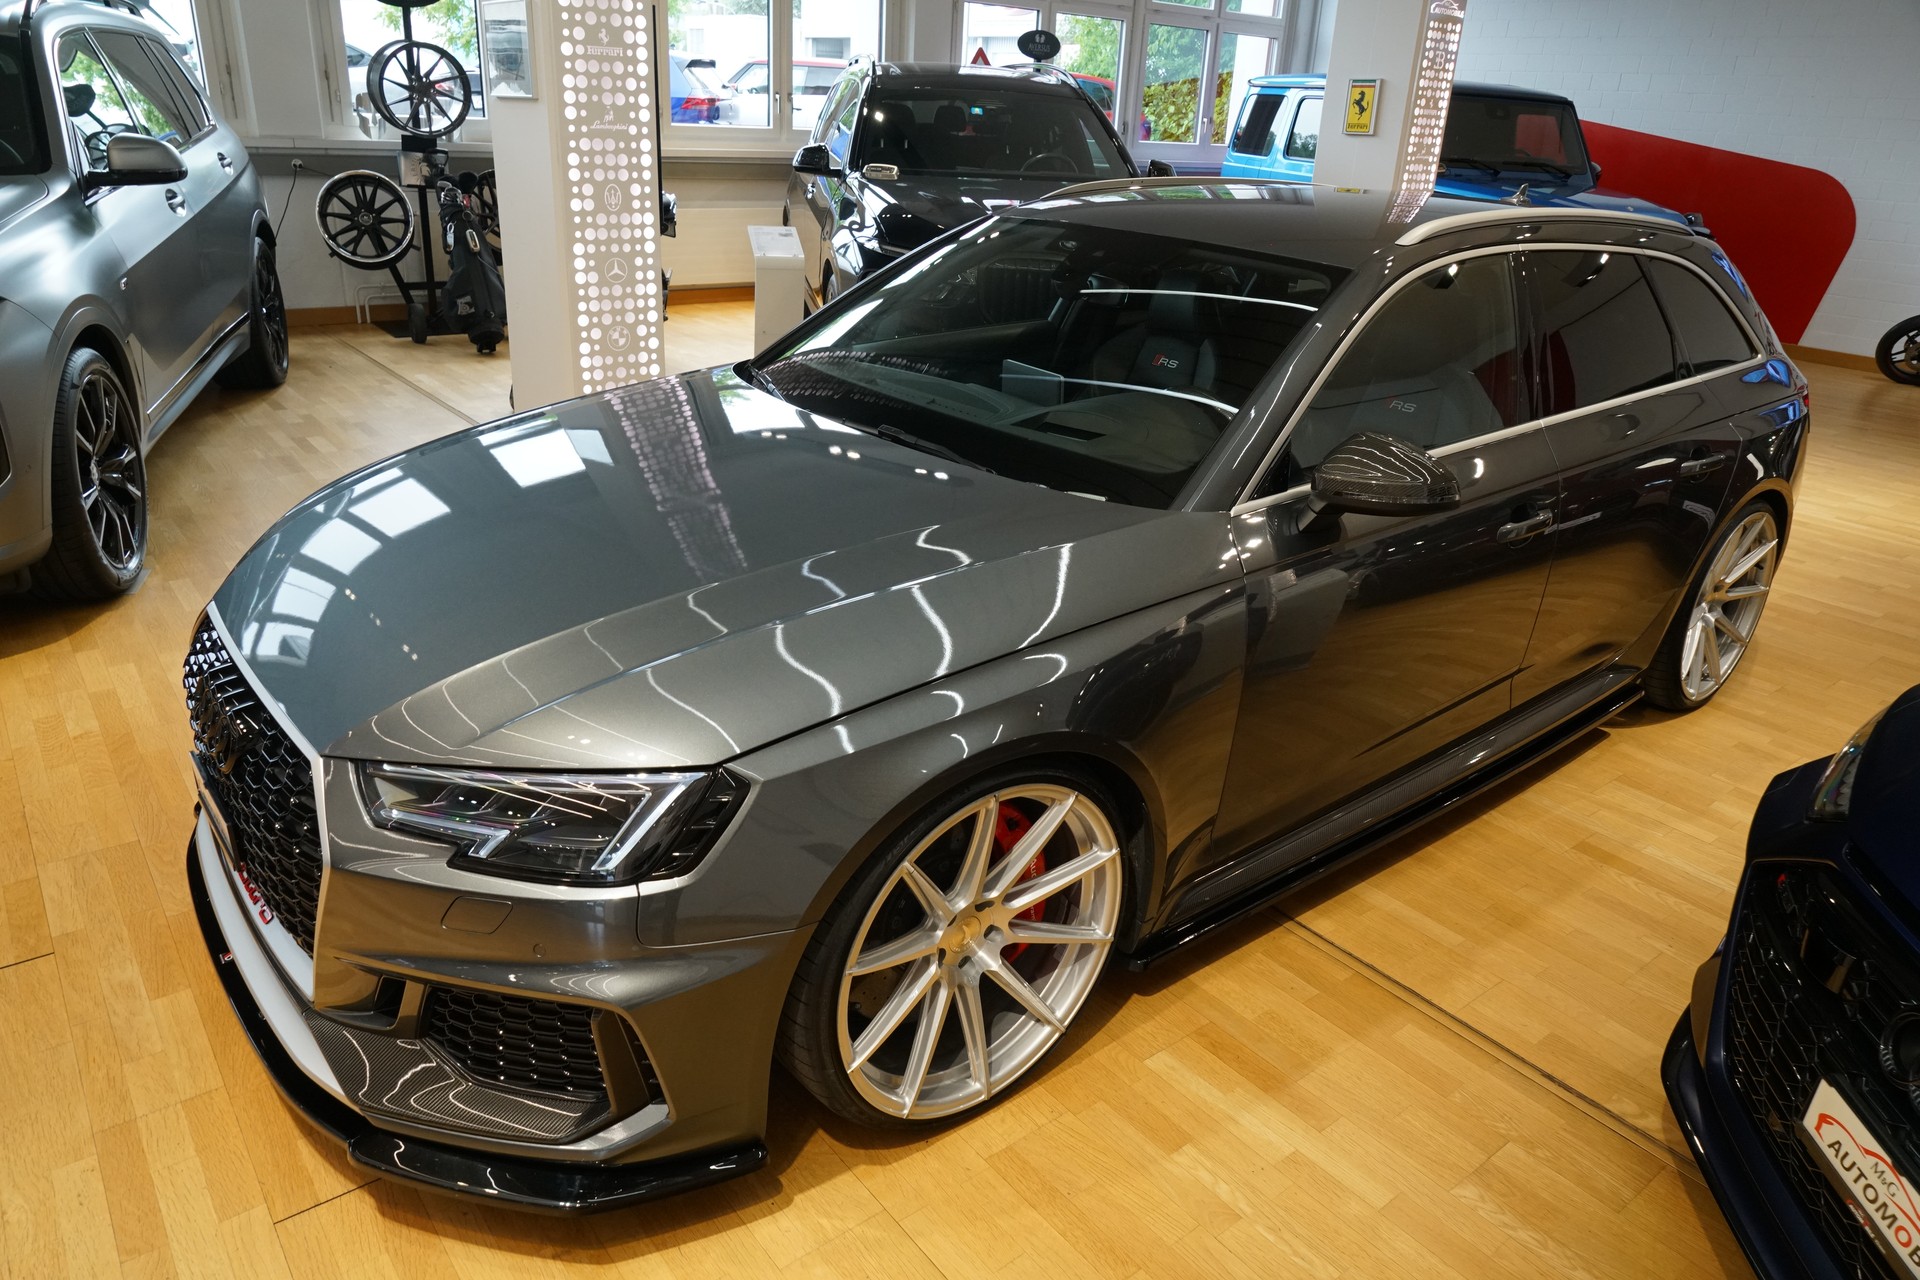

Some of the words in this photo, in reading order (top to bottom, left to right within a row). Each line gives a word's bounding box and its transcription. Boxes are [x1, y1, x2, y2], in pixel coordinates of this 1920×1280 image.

[587, 45, 624, 57] Ferrari
[1347, 122, 1369, 130] Ferrari
[1158, 356, 1179, 369] RS
[1389, 400, 1417, 413] RS
